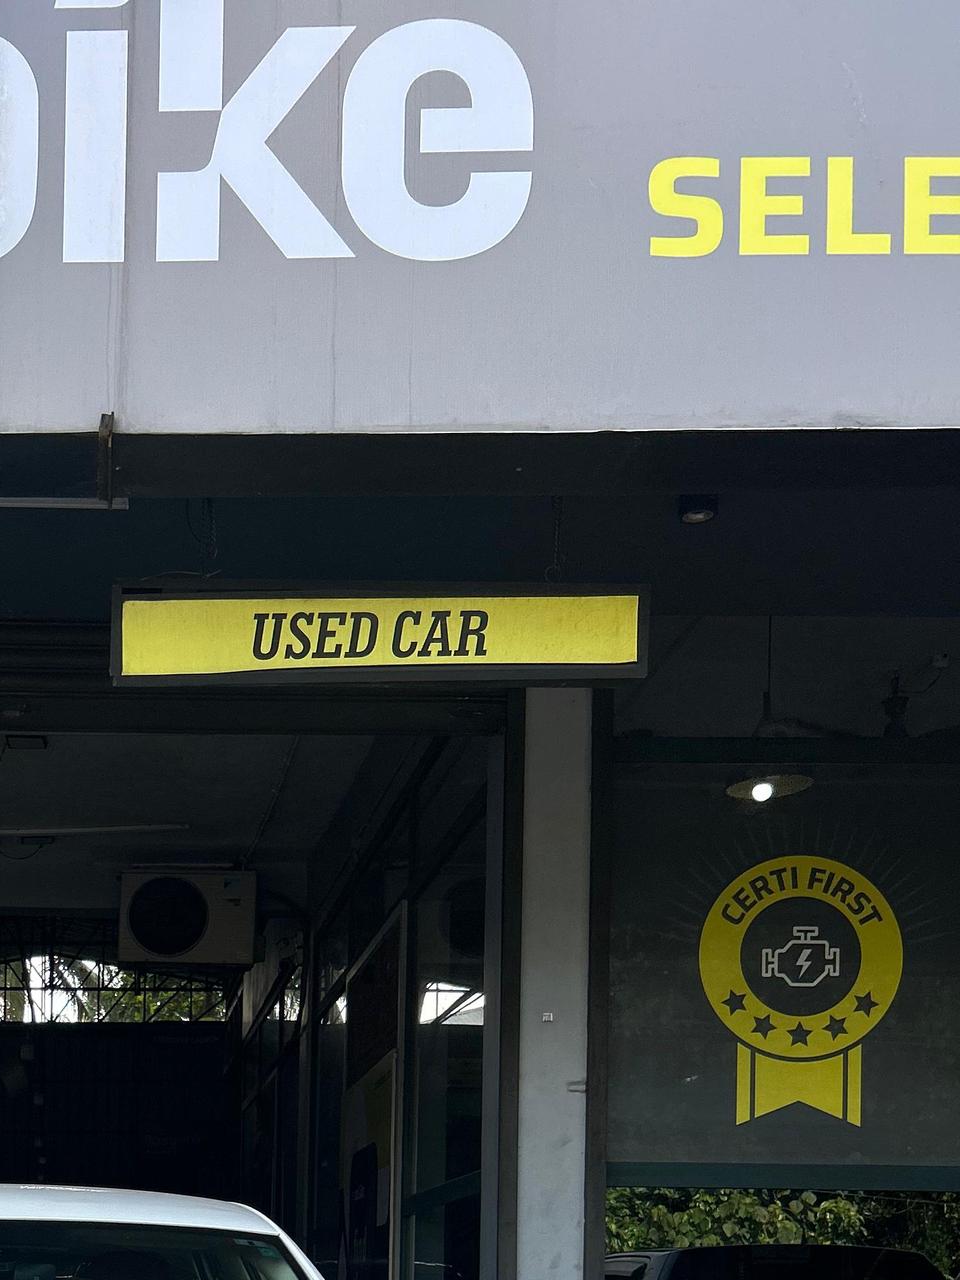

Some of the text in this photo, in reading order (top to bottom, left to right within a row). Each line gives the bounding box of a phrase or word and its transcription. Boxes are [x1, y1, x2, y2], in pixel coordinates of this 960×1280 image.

[252, 609, 489, 661] USED CAR
[721, 866, 883, 926] CERTI FIRST
